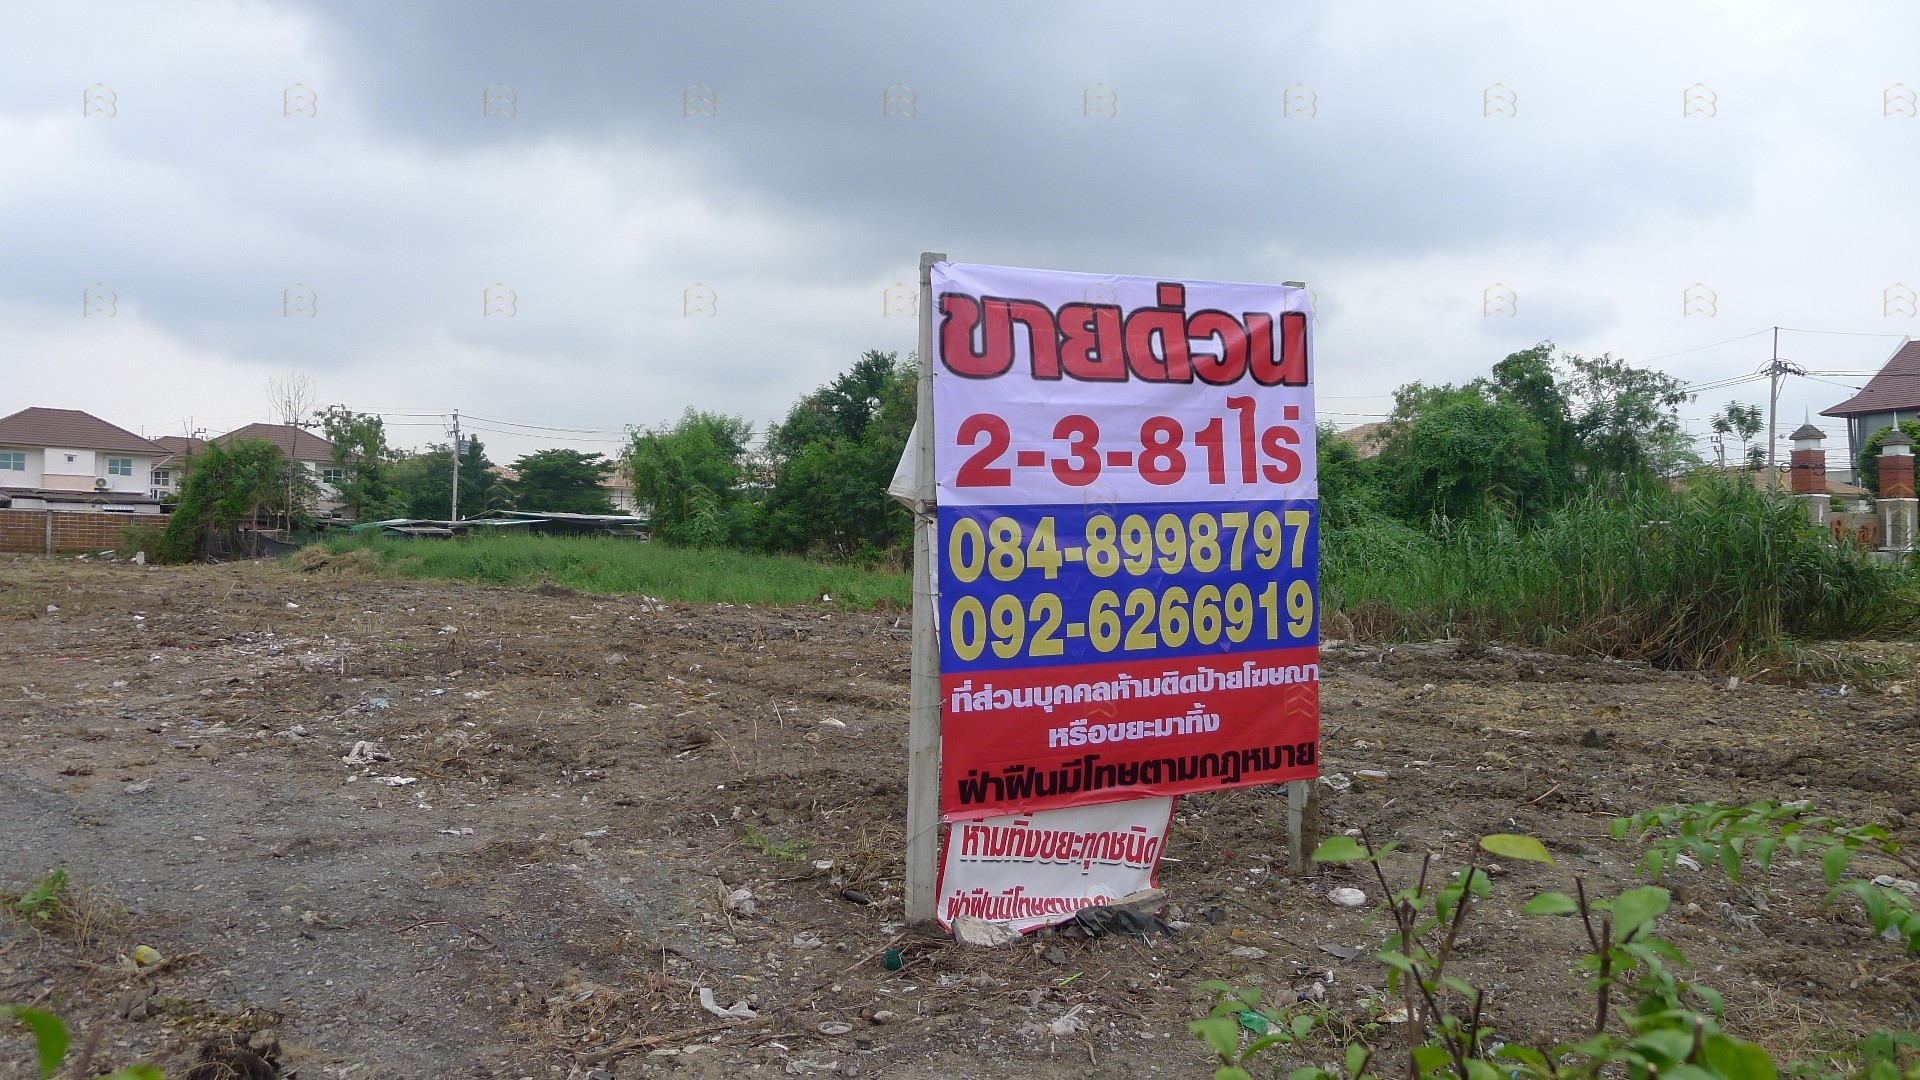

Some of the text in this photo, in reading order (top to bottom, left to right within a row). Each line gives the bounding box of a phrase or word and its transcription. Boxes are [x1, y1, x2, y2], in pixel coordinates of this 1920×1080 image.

[939, 282, 1309, 387] ขายด่วน
[948, 510, 1310, 583] 084-8998797
[950, 579, 1314, 661] 092-6266919
[951, 661, 1319, 713] ที่ส่วนบุคคลห้ามติดป้ายโฆษณา
[1048, 703, 1220, 748] หรือขยะมาทิ้ง
